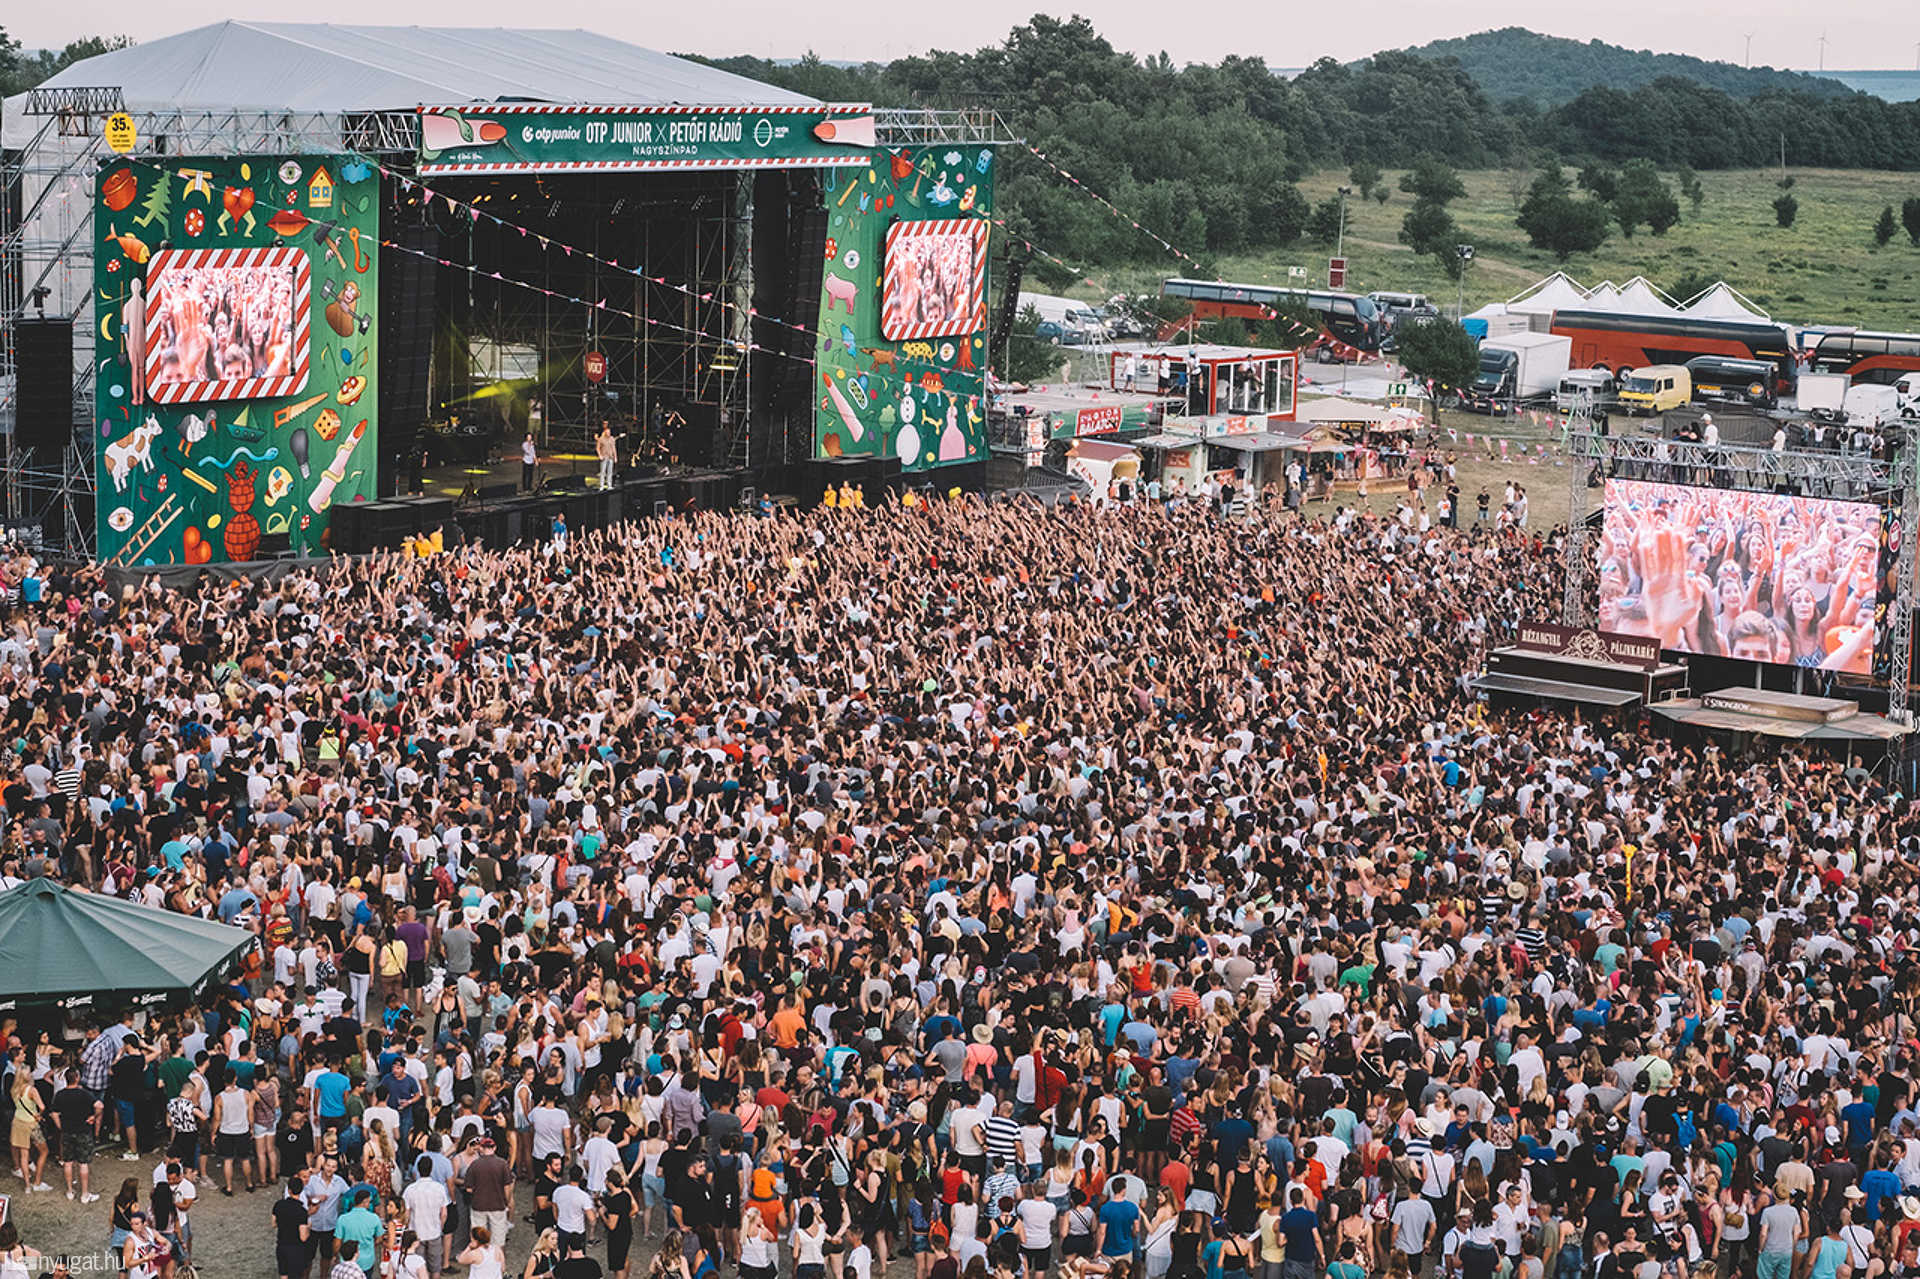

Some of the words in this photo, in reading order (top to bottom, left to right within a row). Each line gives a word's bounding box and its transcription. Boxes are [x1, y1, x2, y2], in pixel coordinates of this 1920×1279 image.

[112, 117, 130, 131] 35.
[586, 122, 608, 143] OTP
[611, 121, 652, 143] JUNIOR
[670, 116, 706, 143] PETŐFI
[709, 115, 743, 142] RÁDIÓ
[632, 143, 698, 155] NAGYSZÍNPAD
